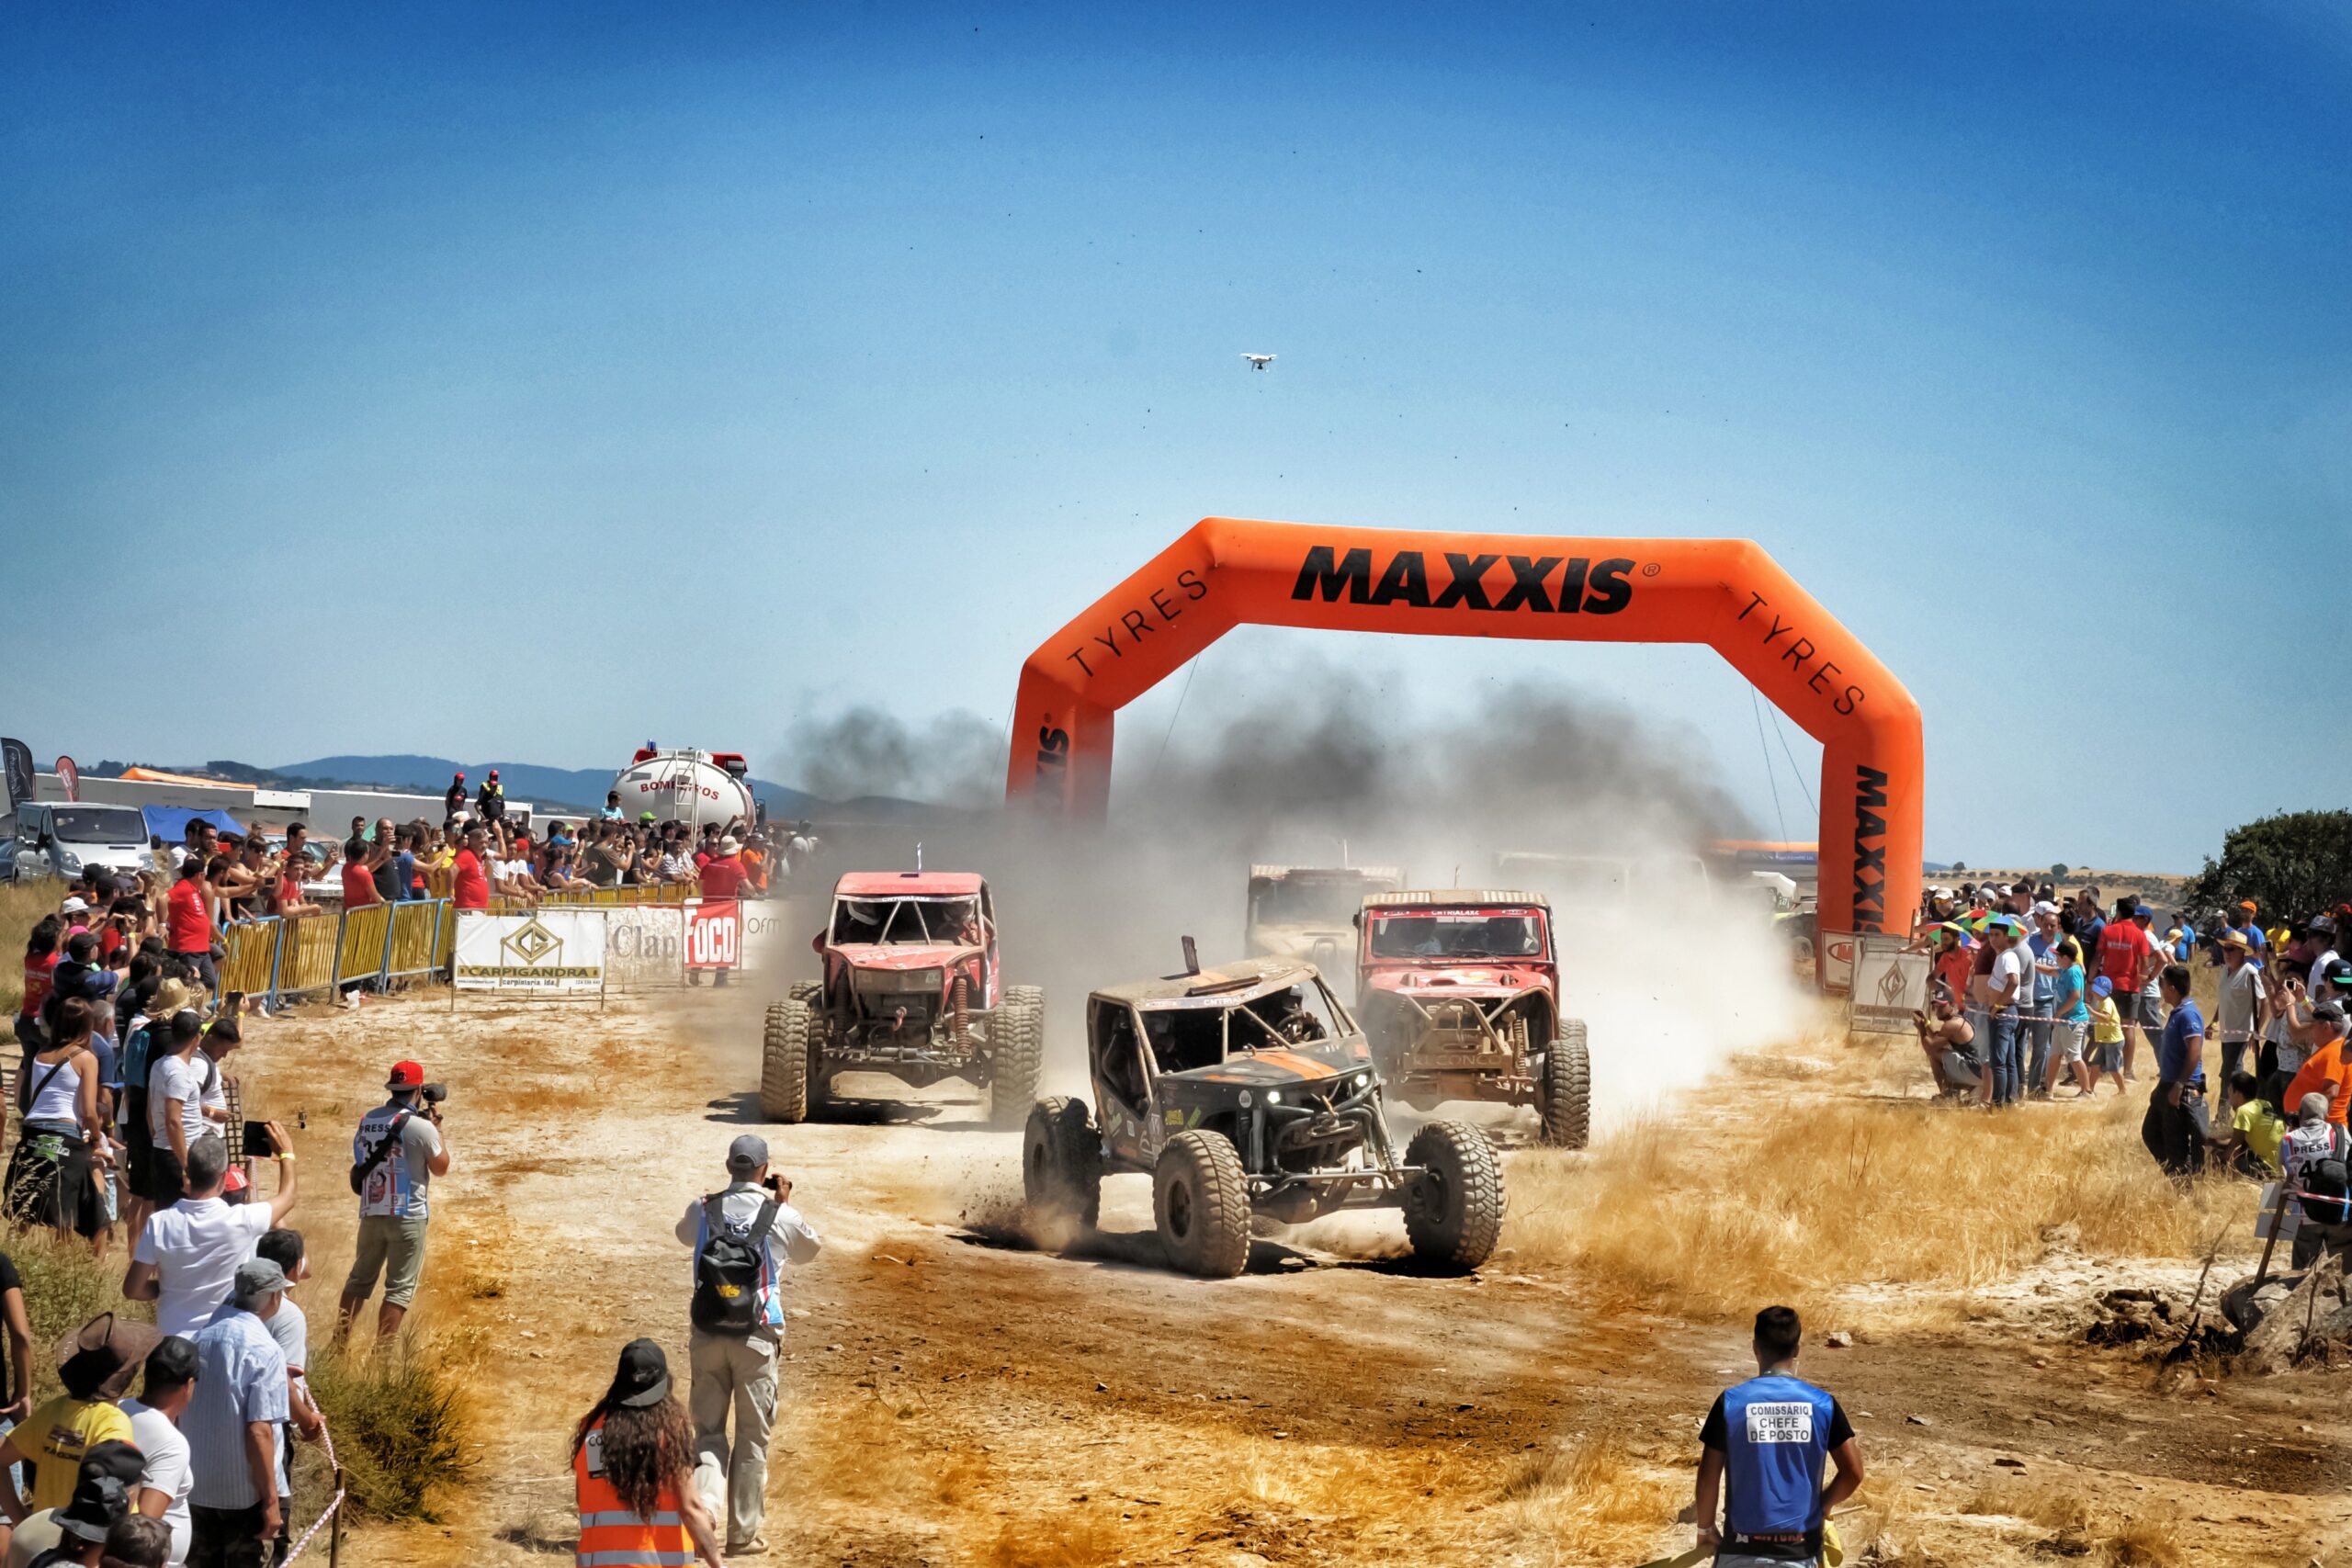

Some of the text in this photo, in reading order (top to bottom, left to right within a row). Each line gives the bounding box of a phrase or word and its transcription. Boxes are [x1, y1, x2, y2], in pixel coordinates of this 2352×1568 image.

[1291, 546, 1636, 615] MAXXIS
[1067, 570, 1207, 677] TYRES
[1738, 591, 1865, 716] TYRES
[612, 925, 677, 959] Clap
[684, 908, 735, 964] FOCO
[469, 967, 589, 977] CARPIGANDRA
[359, 1123, 390, 1134] PRESS
[2293, 1142, 2330, 1155] PRESS
[725, 1223, 751, 1234] RES
[1759, 1417, 1799, 1428] CHEFE
[1750, 1429, 1809, 1441] DE POSTO
